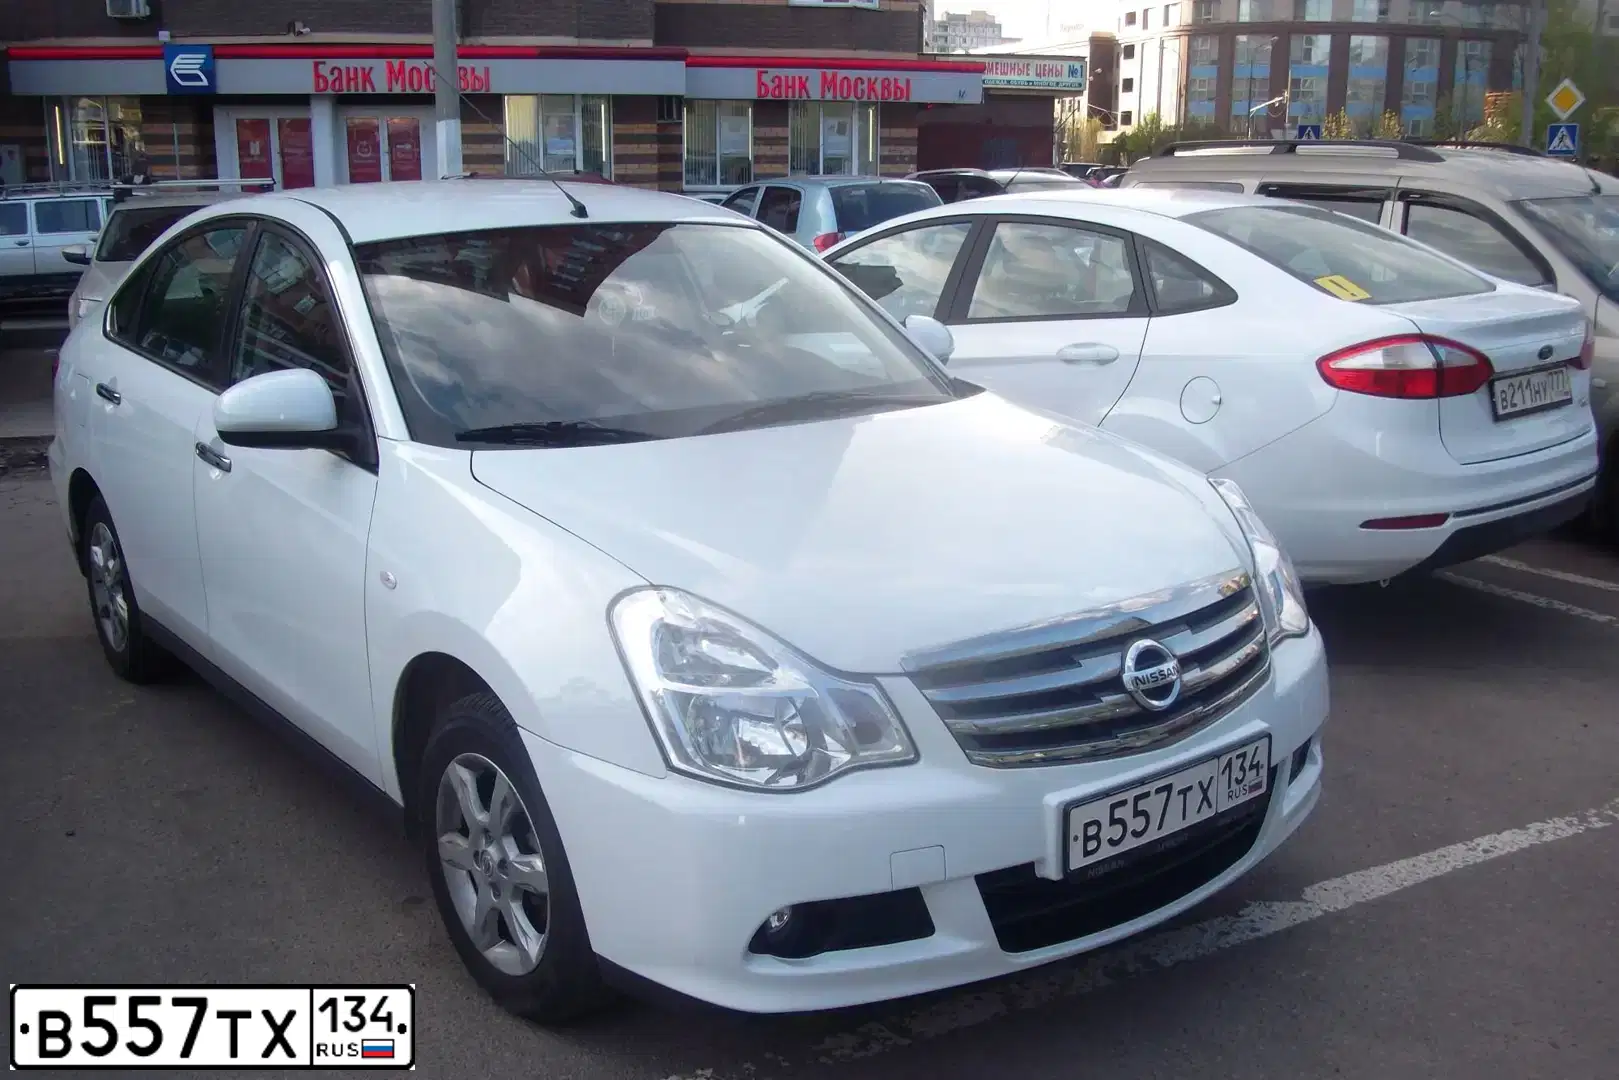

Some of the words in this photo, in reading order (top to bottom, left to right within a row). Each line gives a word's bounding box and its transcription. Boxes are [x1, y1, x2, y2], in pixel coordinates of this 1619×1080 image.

[312, 60, 376, 92] Банк
[385, 60, 491, 92] Мосвы
[985, 61, 1031, 76] МЕШНЫЕ
[1035, 63, 1064, 79] ЦЕНЫ
[756, 70, 811, 99] Банк
[820, 71, 911, 101] Москвы
[1133, 663, 1179, 687] NISSAN
[1082, 776, 1214, 858] В557ТХ
[1221, 746, 1260, 789] 134
[1227, 786, 1248, 802] RUS
